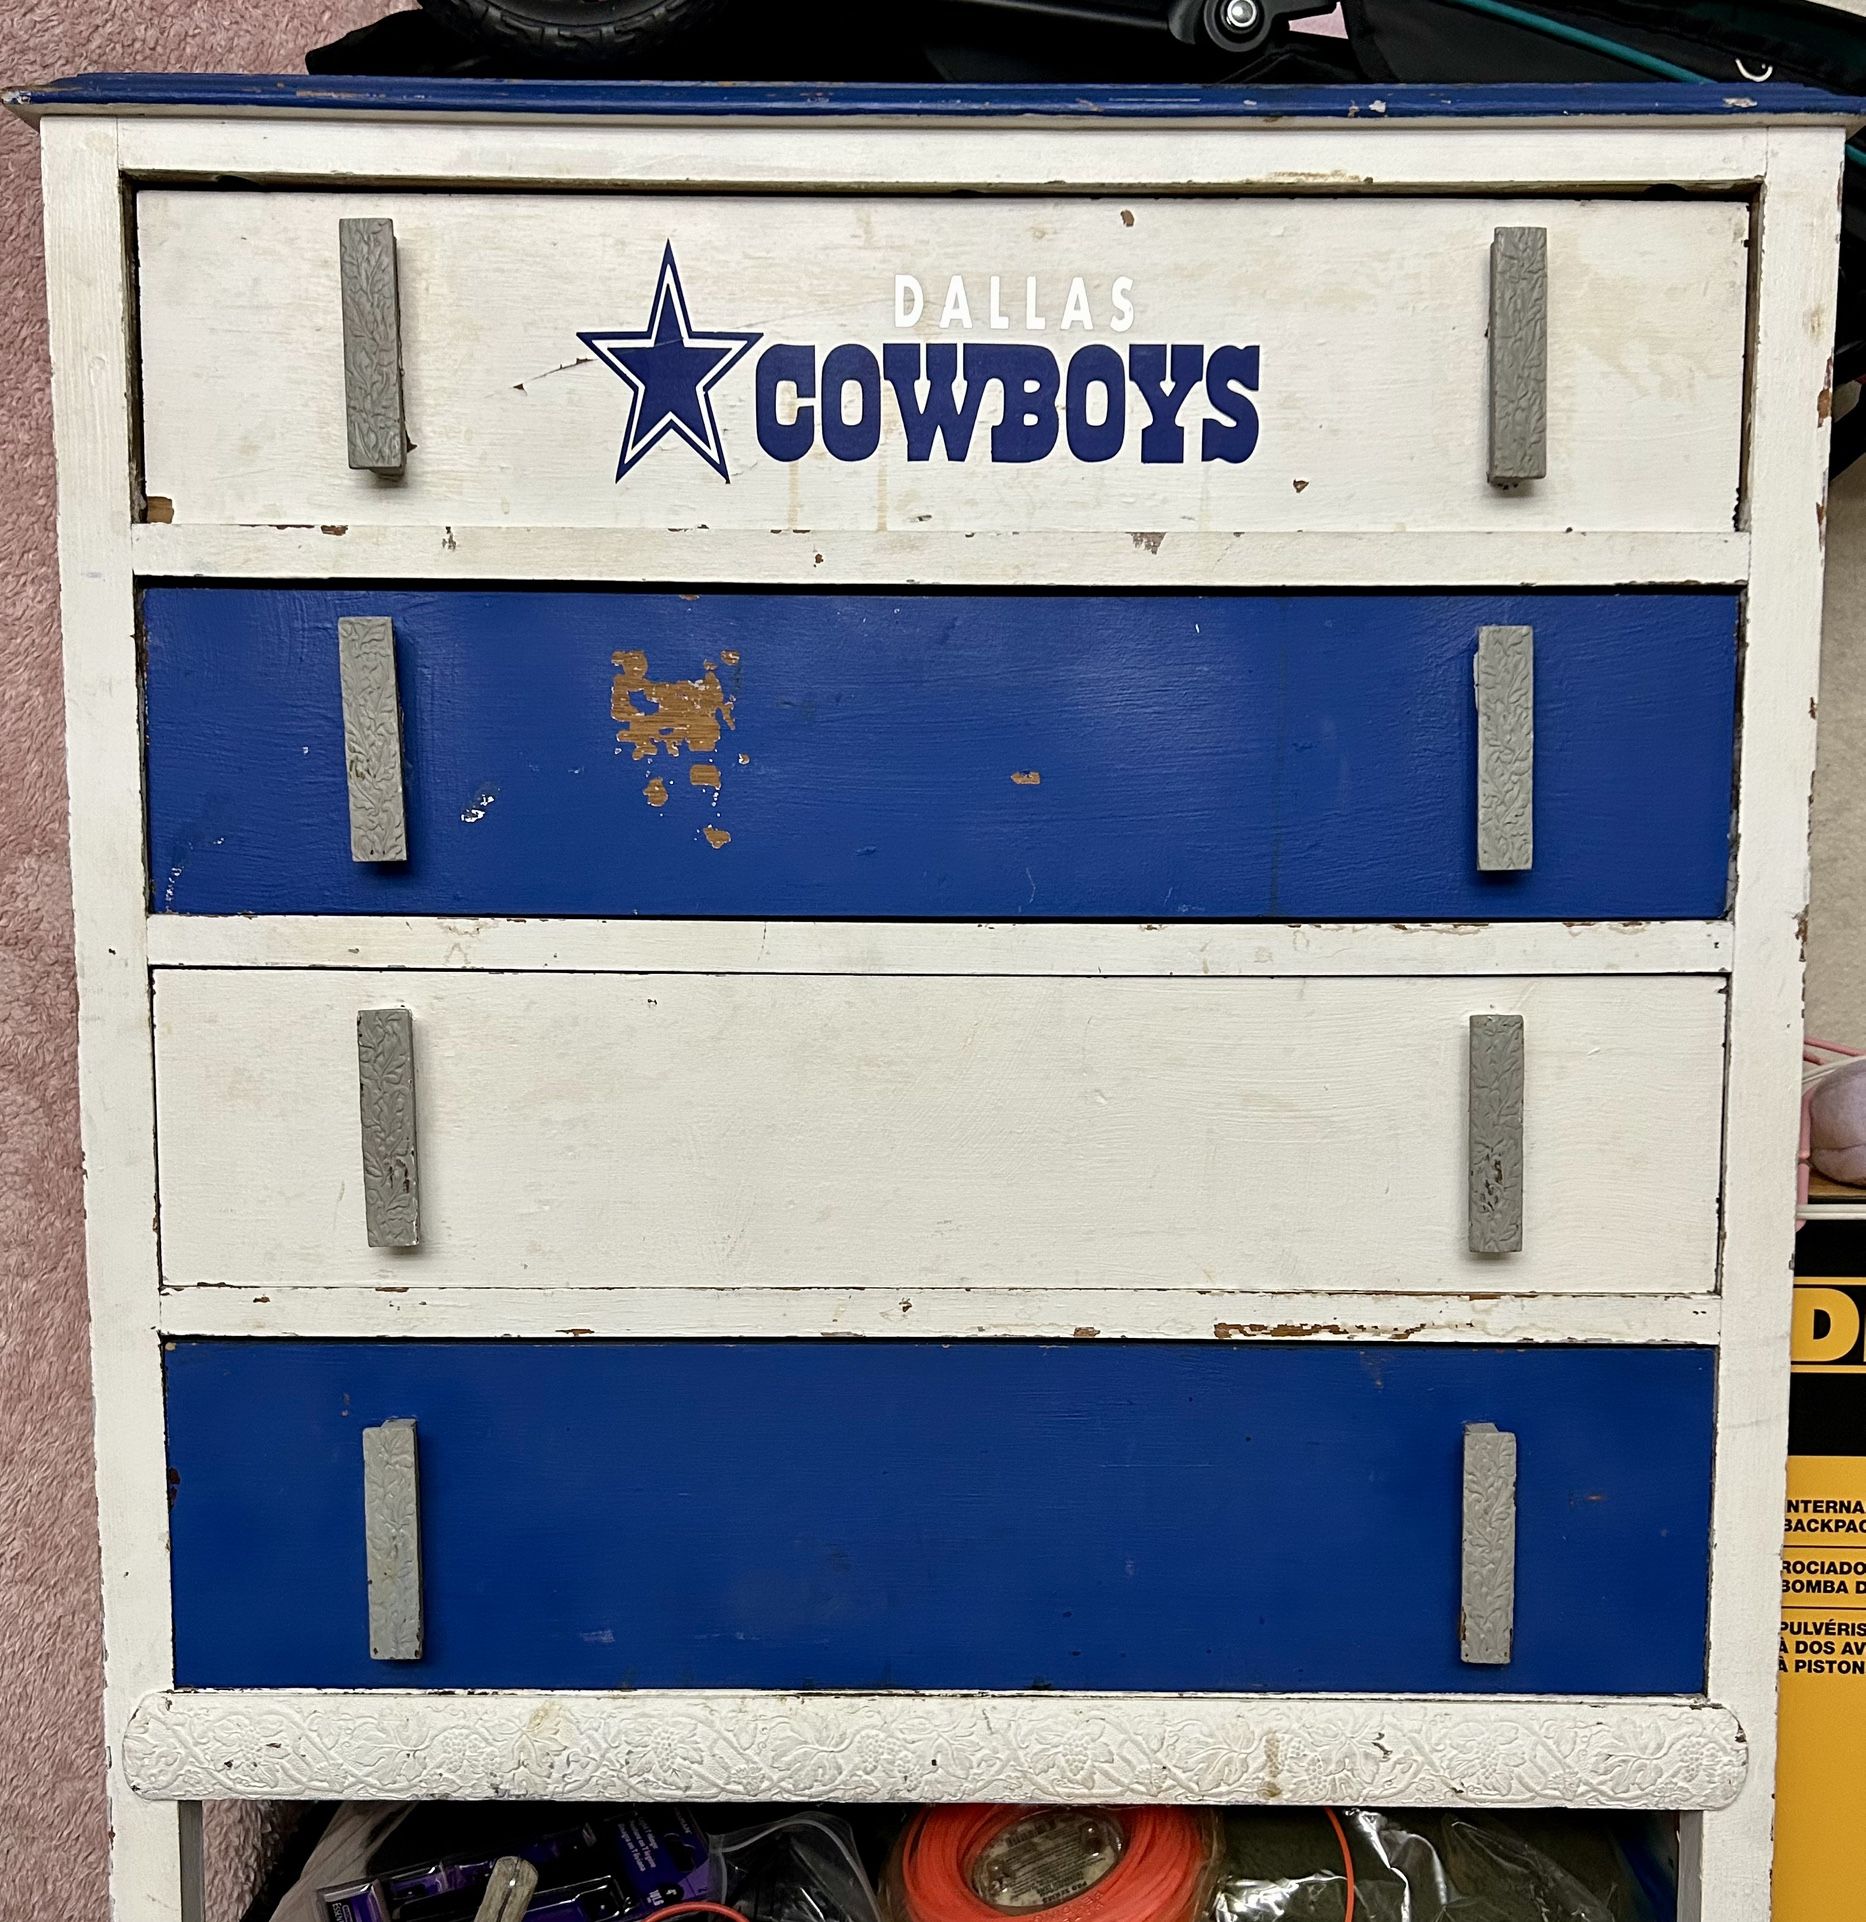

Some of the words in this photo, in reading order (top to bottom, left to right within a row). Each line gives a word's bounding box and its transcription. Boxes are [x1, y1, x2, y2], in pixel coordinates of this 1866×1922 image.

[893, 273, 1136, 333] DALLAS
[754, 342, 1261, 464] COWBOYS
[1785, 1499, 1866, 1514] NTERNA
[1781, 1579, 1849, 1593] BOMBA
[1795, 1640, 1836, 1655] DOS
[1794, 1659, 1865, 1675] PISTON
